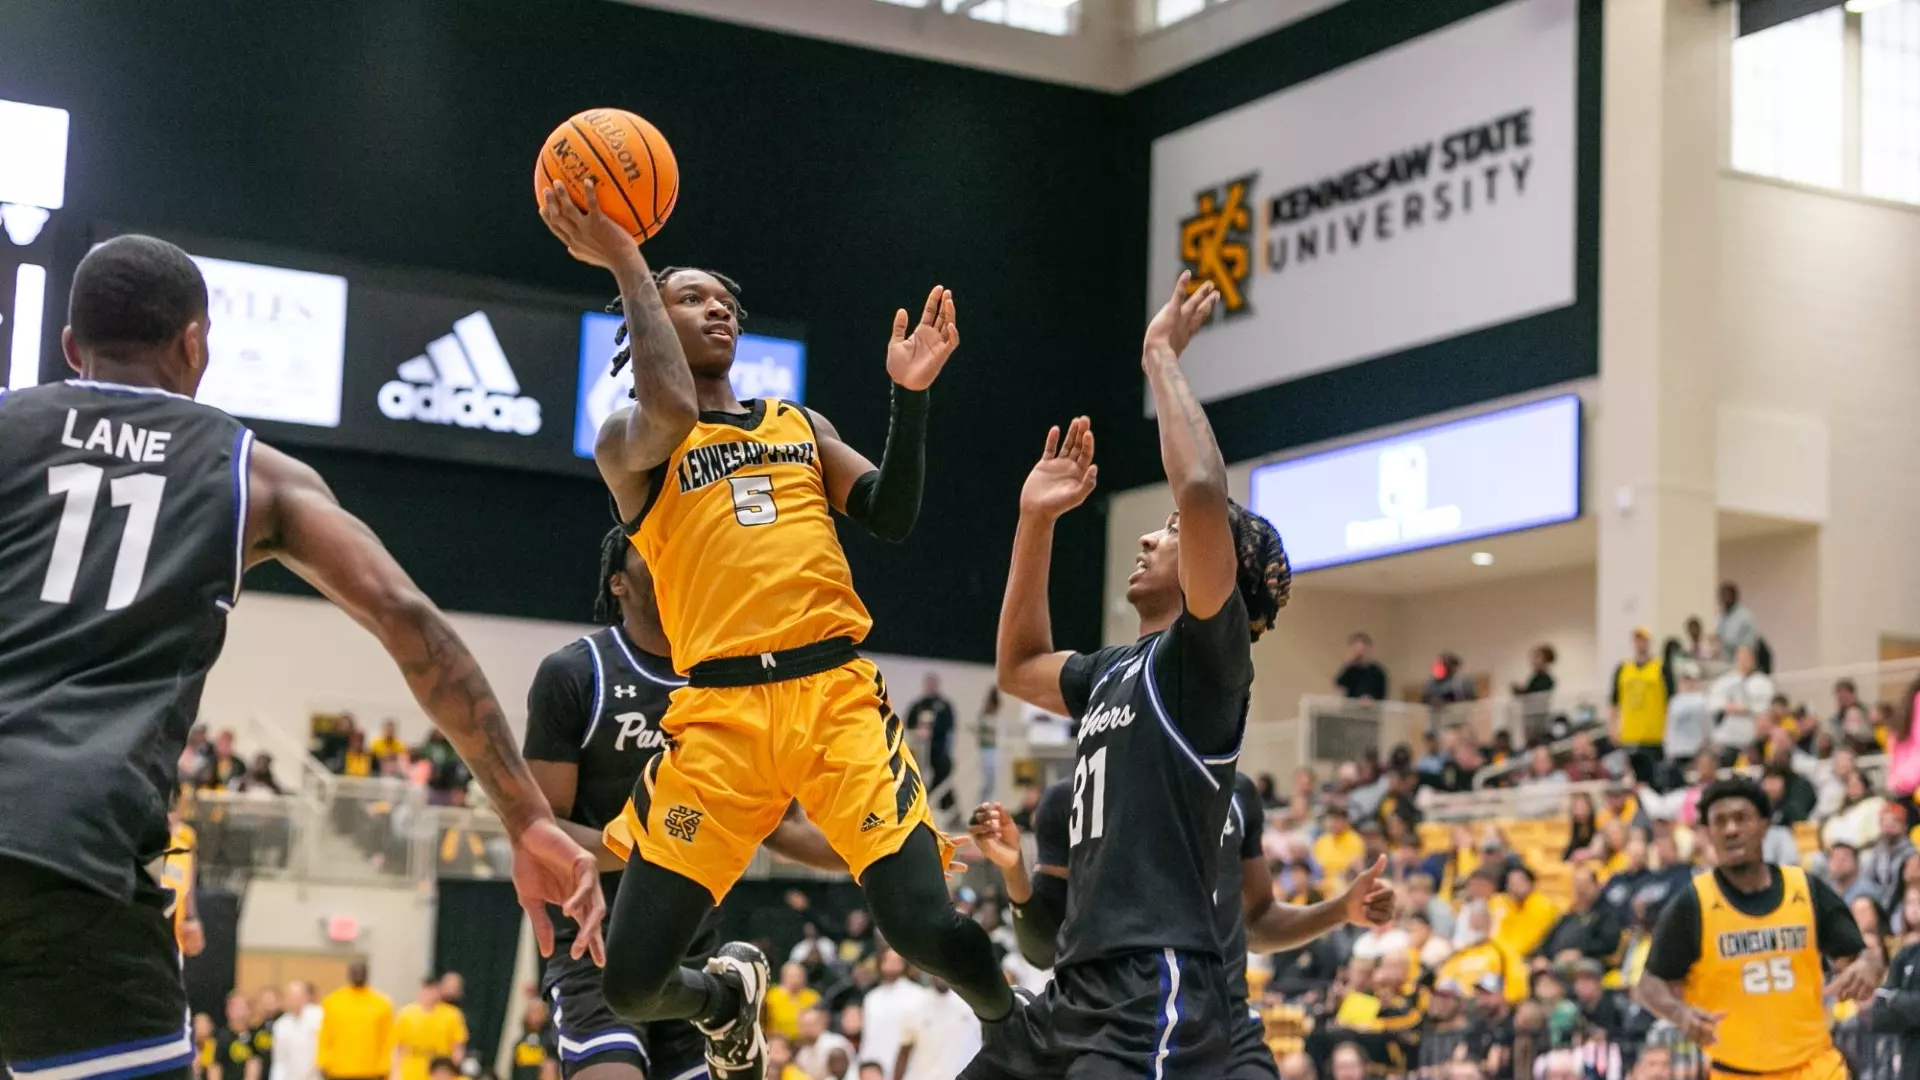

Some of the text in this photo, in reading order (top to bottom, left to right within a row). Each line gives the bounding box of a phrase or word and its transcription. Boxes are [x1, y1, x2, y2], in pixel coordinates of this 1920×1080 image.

[583, 111, 641, 184] Wilson
[1270, 108, 1534, 226] KENNESAW STATE
[1268, 156, 1533, 274] UNIVERSITY
[62, 408, 172, 463] LANE
[376, 380, 542, 436] adidas
[40, 462, 167, 612] 11
[727, 474, 779, 527] 5
[1069, 745, 1108, 849] 31
[1742, 956, 1795, 994] 25
